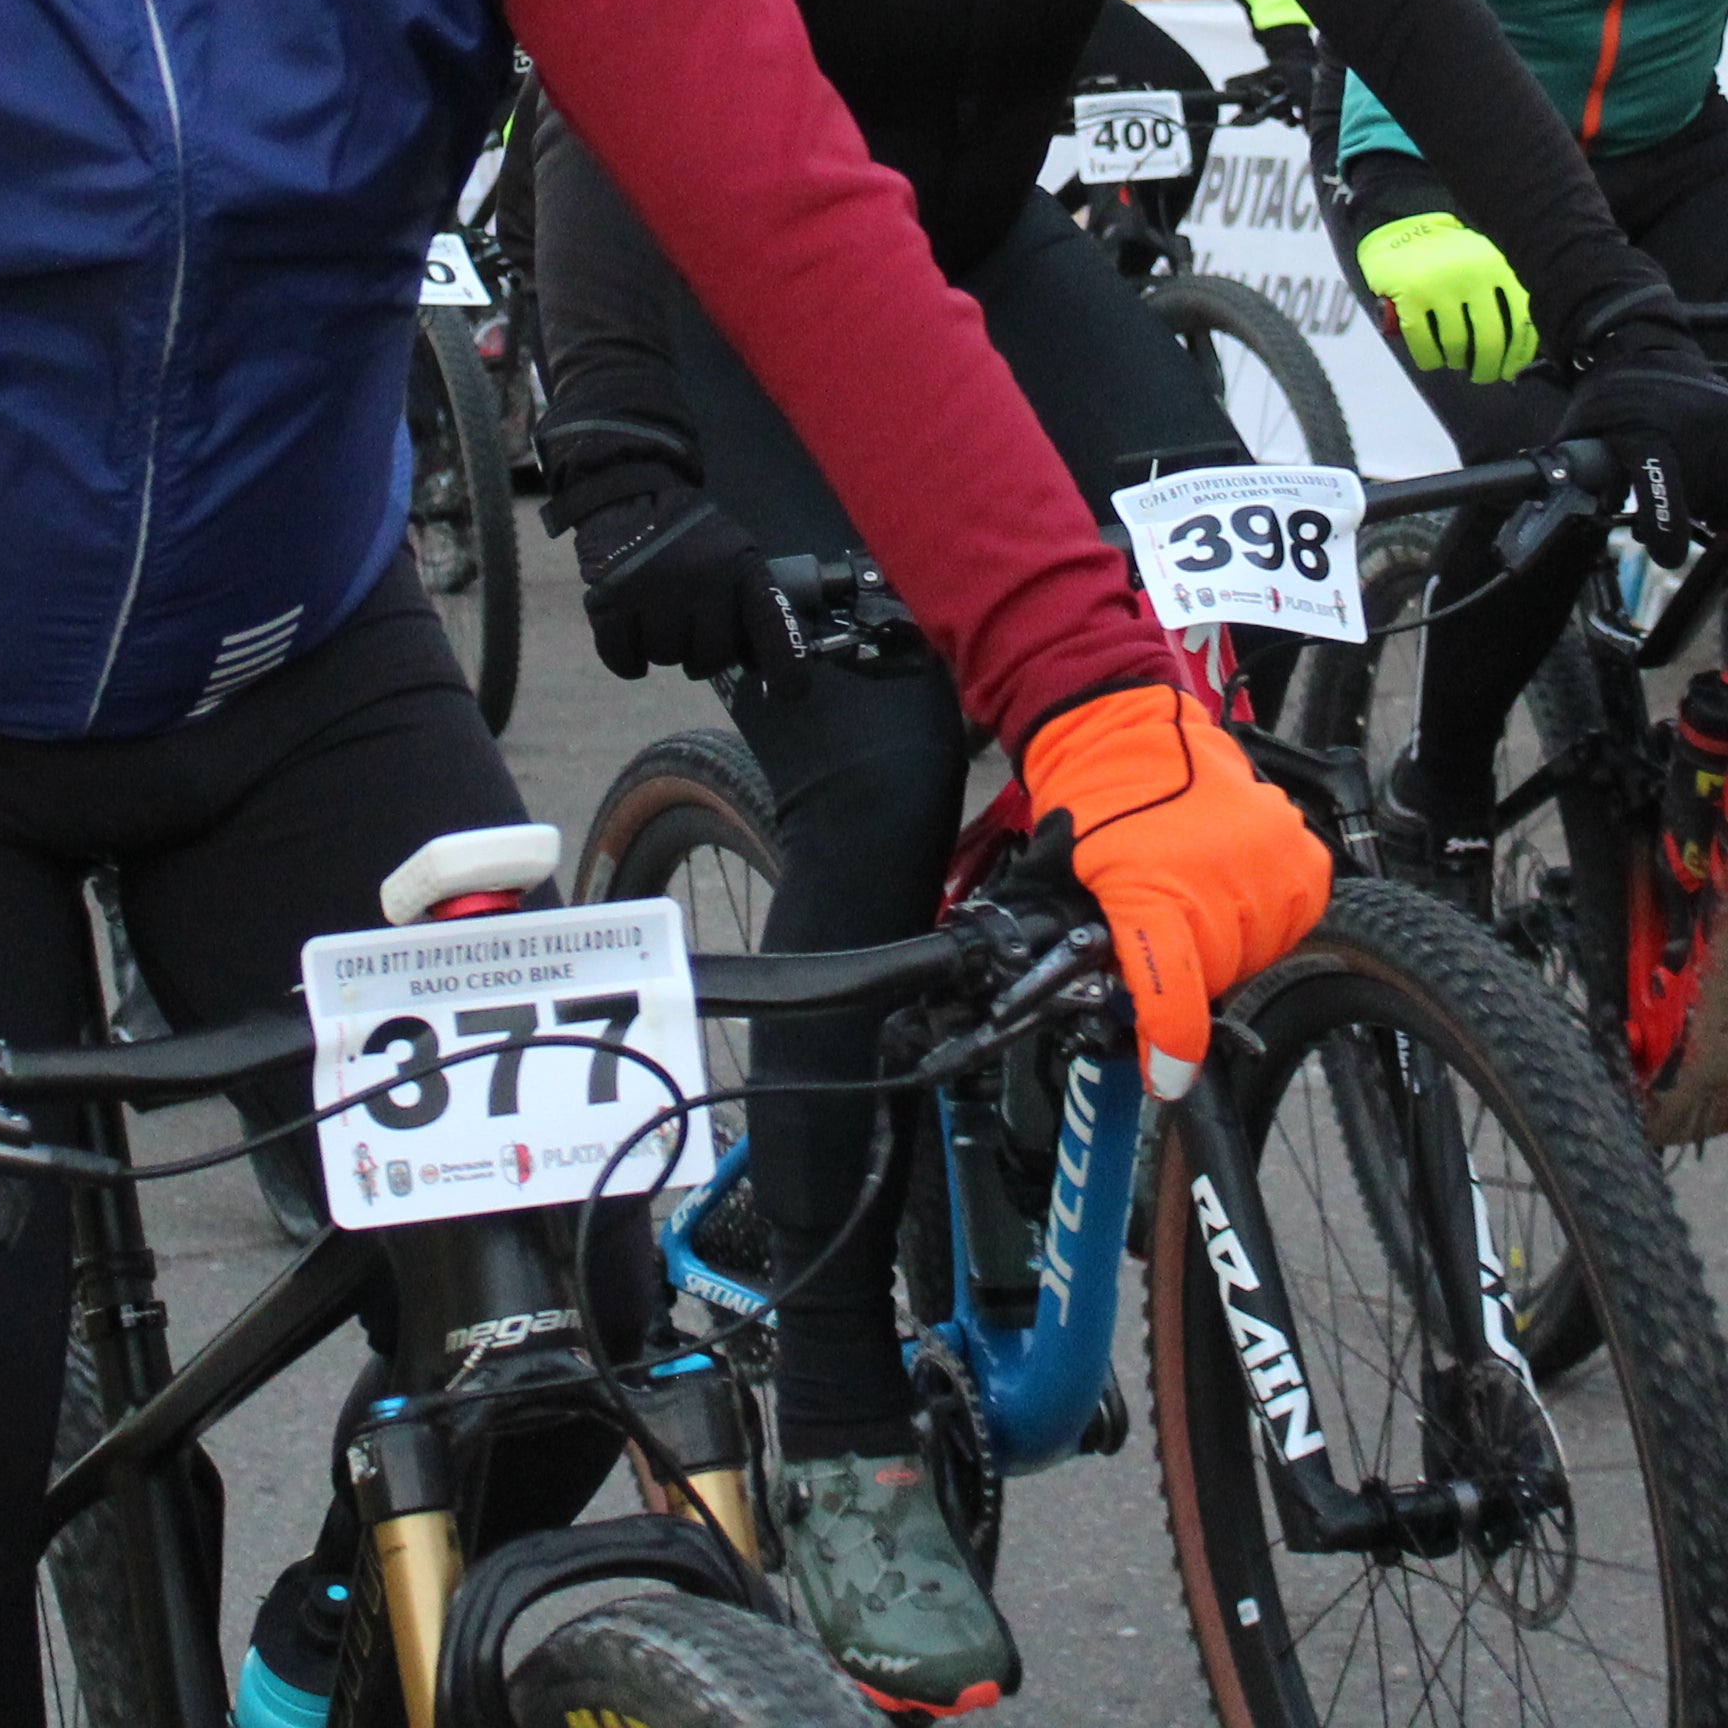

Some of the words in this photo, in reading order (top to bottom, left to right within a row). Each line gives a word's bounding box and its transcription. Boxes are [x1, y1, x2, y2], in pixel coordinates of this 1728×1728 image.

[1092, 118, 1175, 153] 400
[1641, 457, 1671, 532] reusch
[1168, 503, 1333, 583] 398
[334, 955, 376, 981] COPA
[380, 950, 411, 975] BTT
[415, 936, 513, 971] DIPUTACIÓN
[515, 936, 539, 959] DE
[543, 925, 644, 955] VALLADOLID
[409, 975, 461, 997] BAJO
[466, 968, 523, 989] CERO
[528, 961, 577, 982] BIKE
[361, 989, 642, 1131] 377
